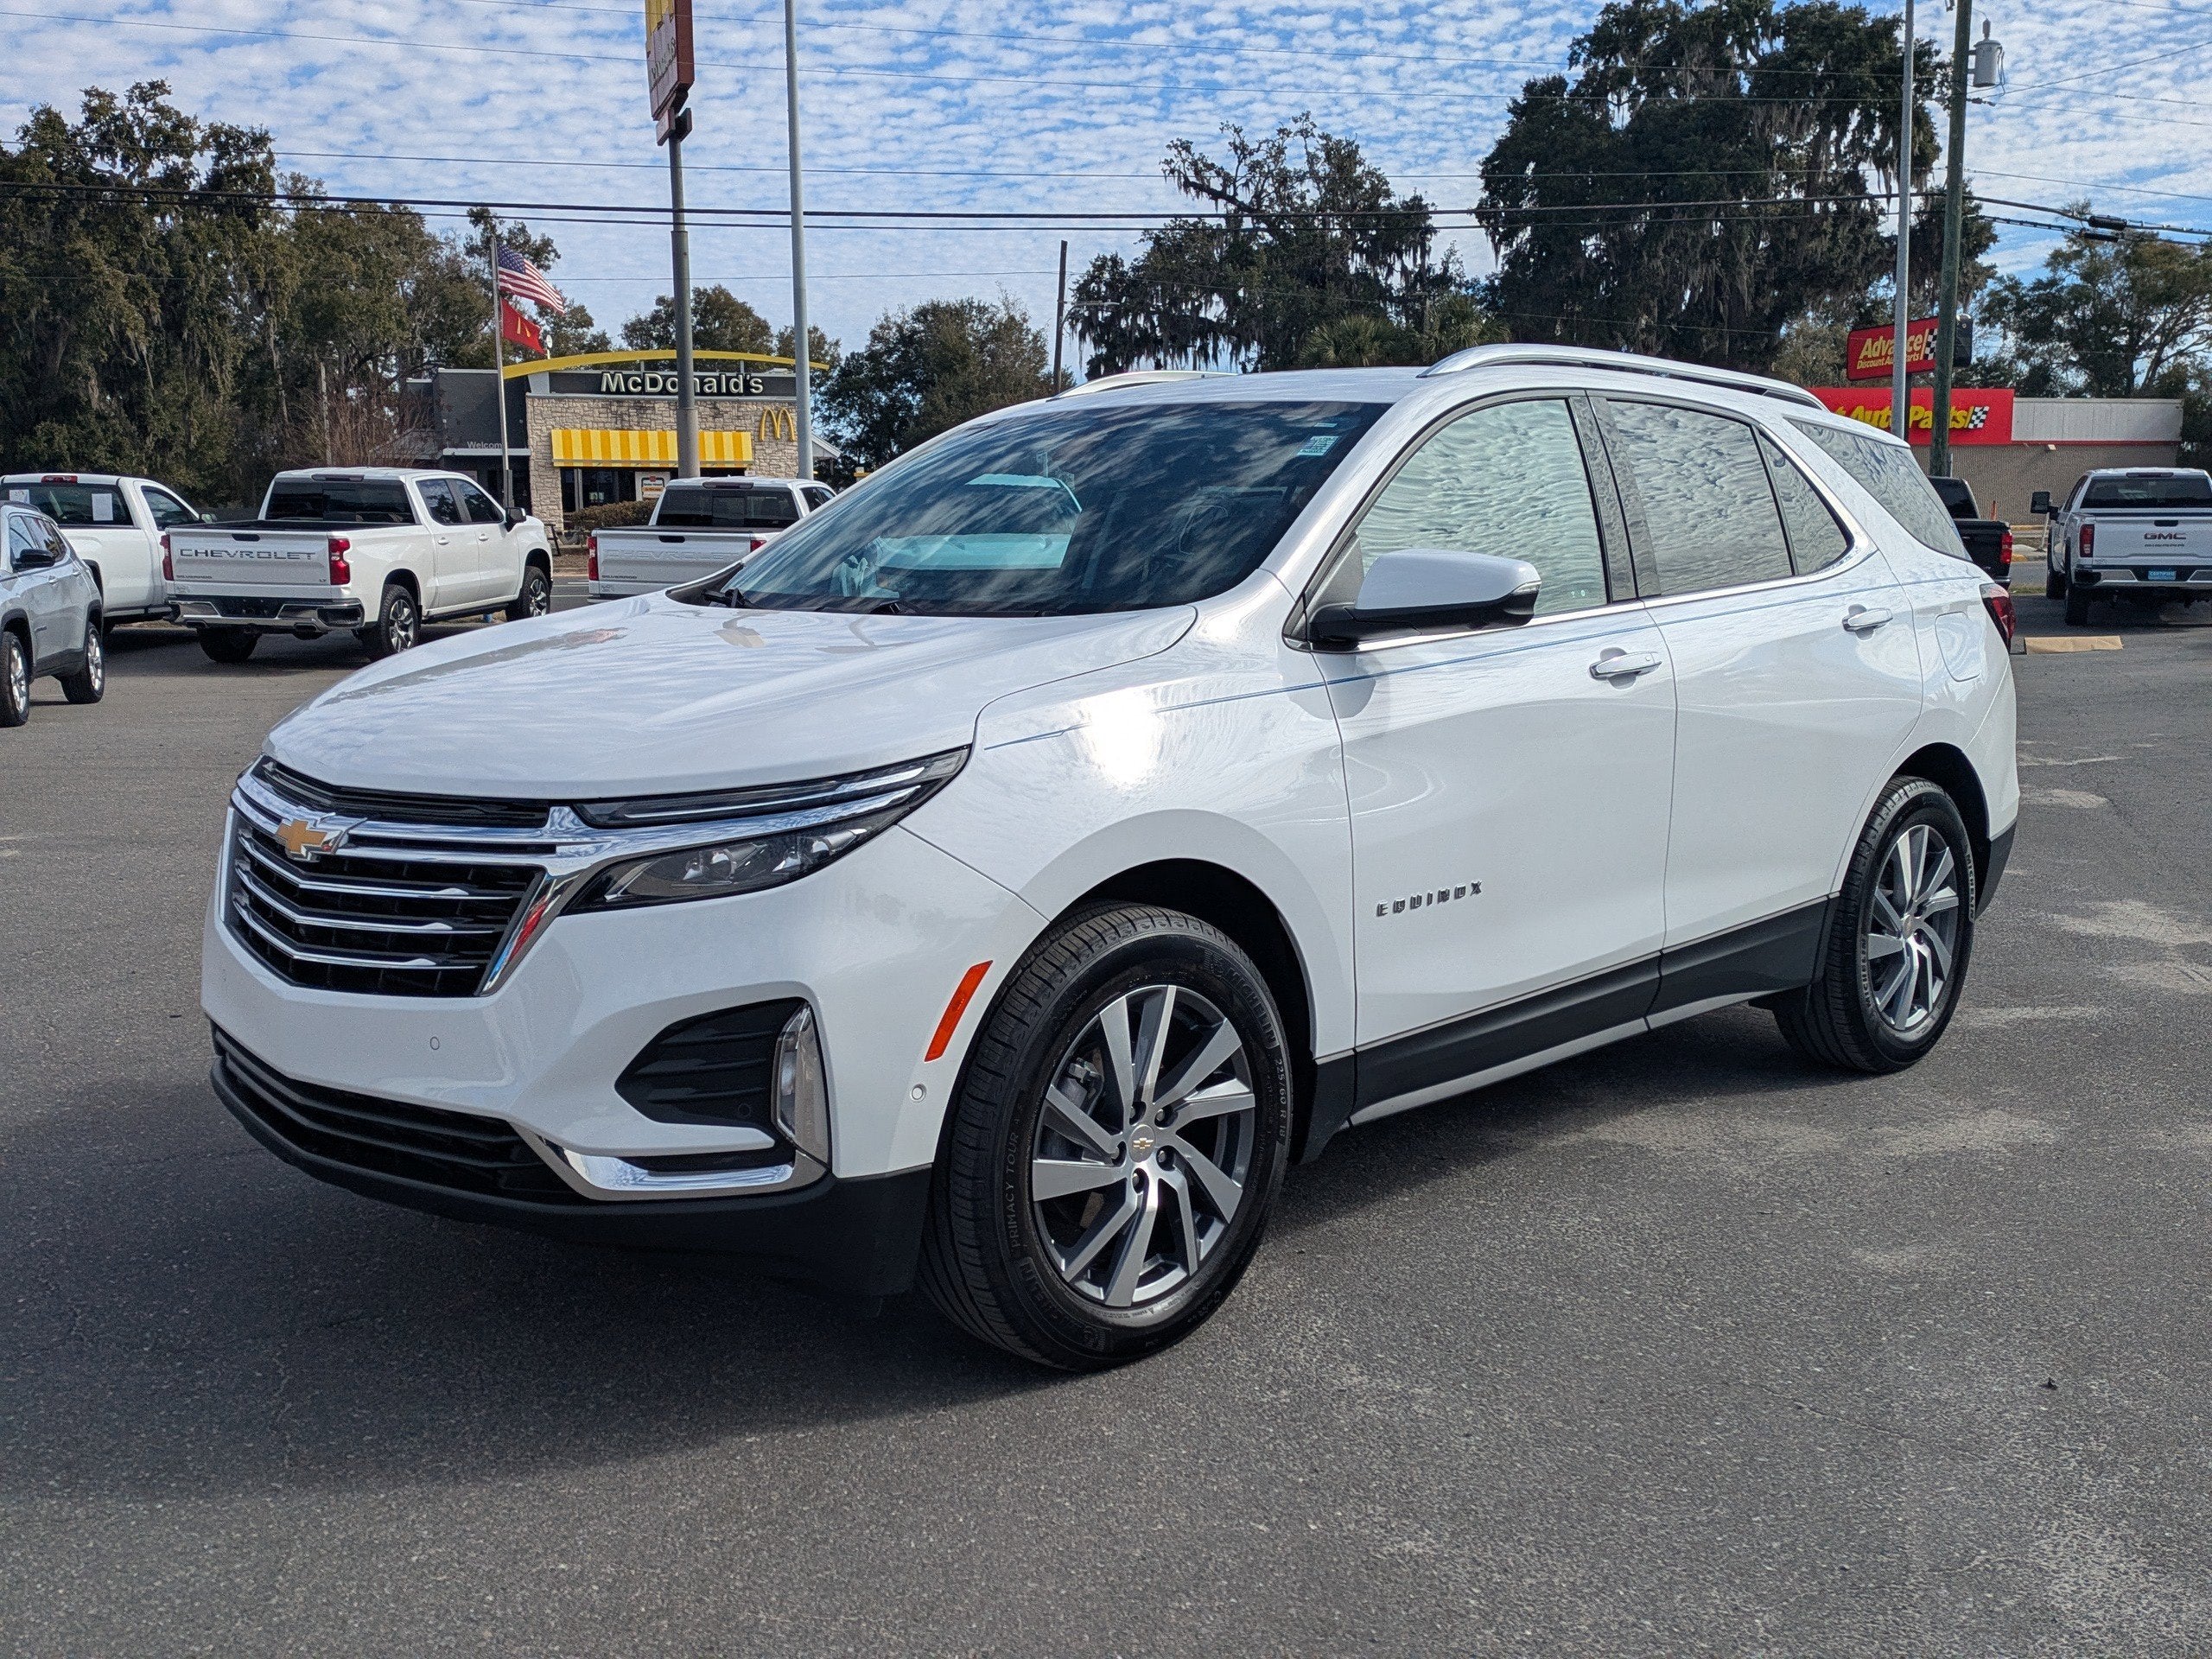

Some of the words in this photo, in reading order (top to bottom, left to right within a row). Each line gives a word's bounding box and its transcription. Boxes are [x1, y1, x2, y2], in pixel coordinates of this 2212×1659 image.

[1859, 334, 1923, 359] Advace
[1857, 357, 1885, 370] Discount
[1910, 405, 1967, 429] Pats
[180, 549, 316, 561] CHEVROLET
[1376, 880, 1483, 918] EQUINOX
[1274, 1058, 1287, 1105] 225/60
[1280, 1109, 1287, 1119] R
[1006, 1131, 1020, 1174] TOUR
[1005, 1180, 1021, 1248] PRIMACY
